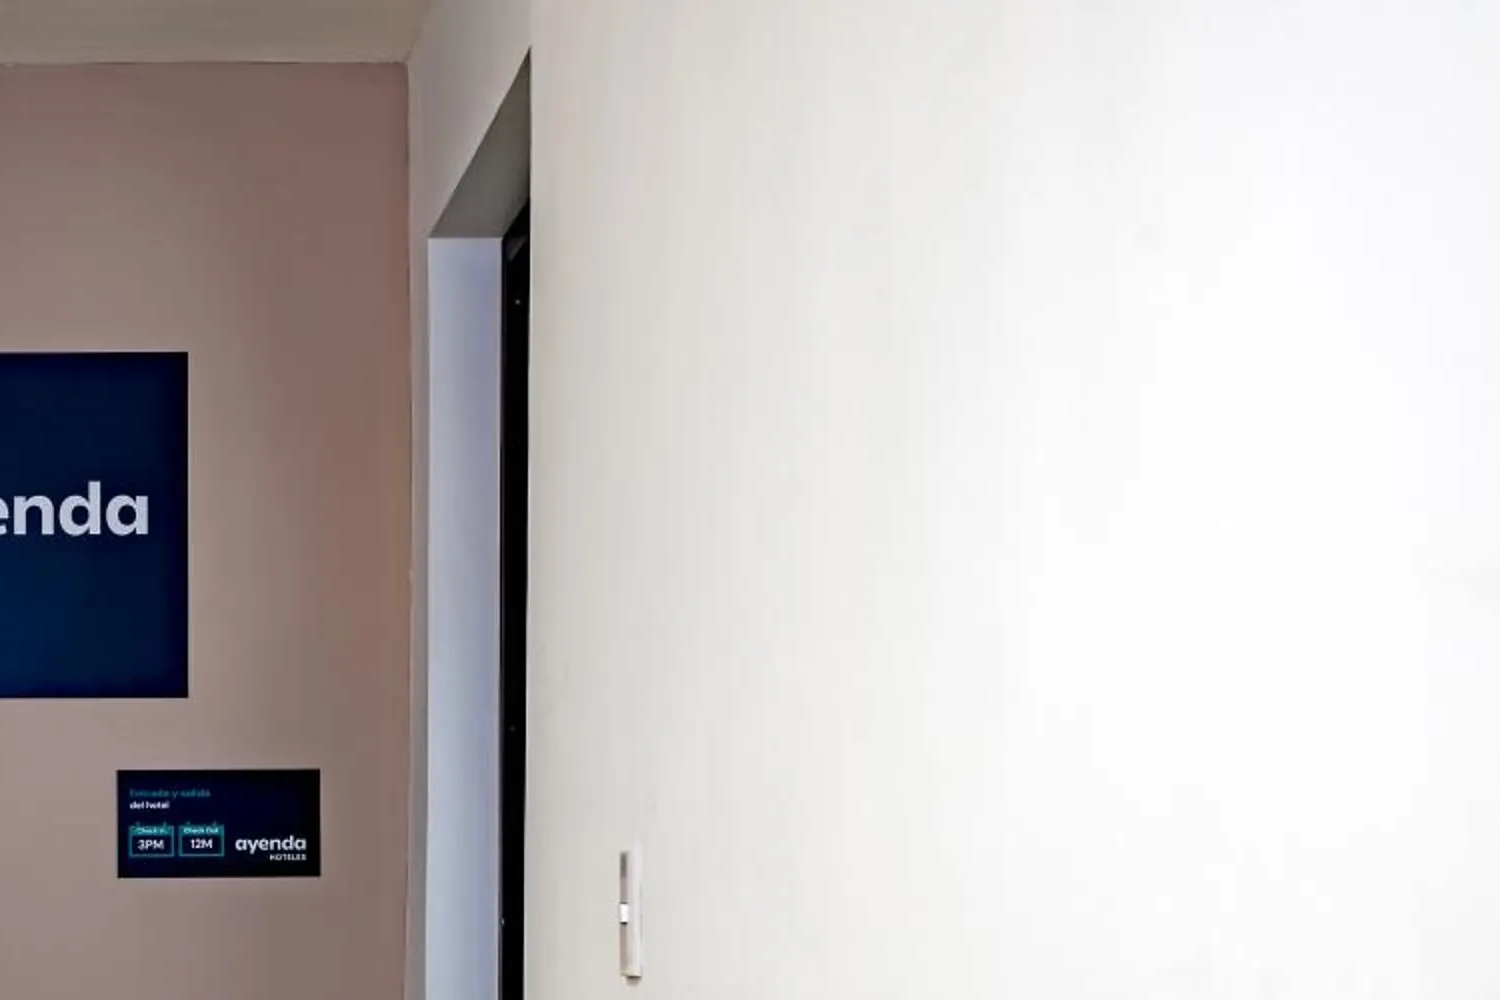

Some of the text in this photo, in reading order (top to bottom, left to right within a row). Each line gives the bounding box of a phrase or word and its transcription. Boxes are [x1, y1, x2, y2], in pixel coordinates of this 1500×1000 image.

[129, 800, 171, 810] del hotel
[137, 839, 165, 850] 3PM
[190, 838, 213, 849] 12M
[235, 835, 307, 854] ayenda
[269, 853, 307, 861] HOTELES
